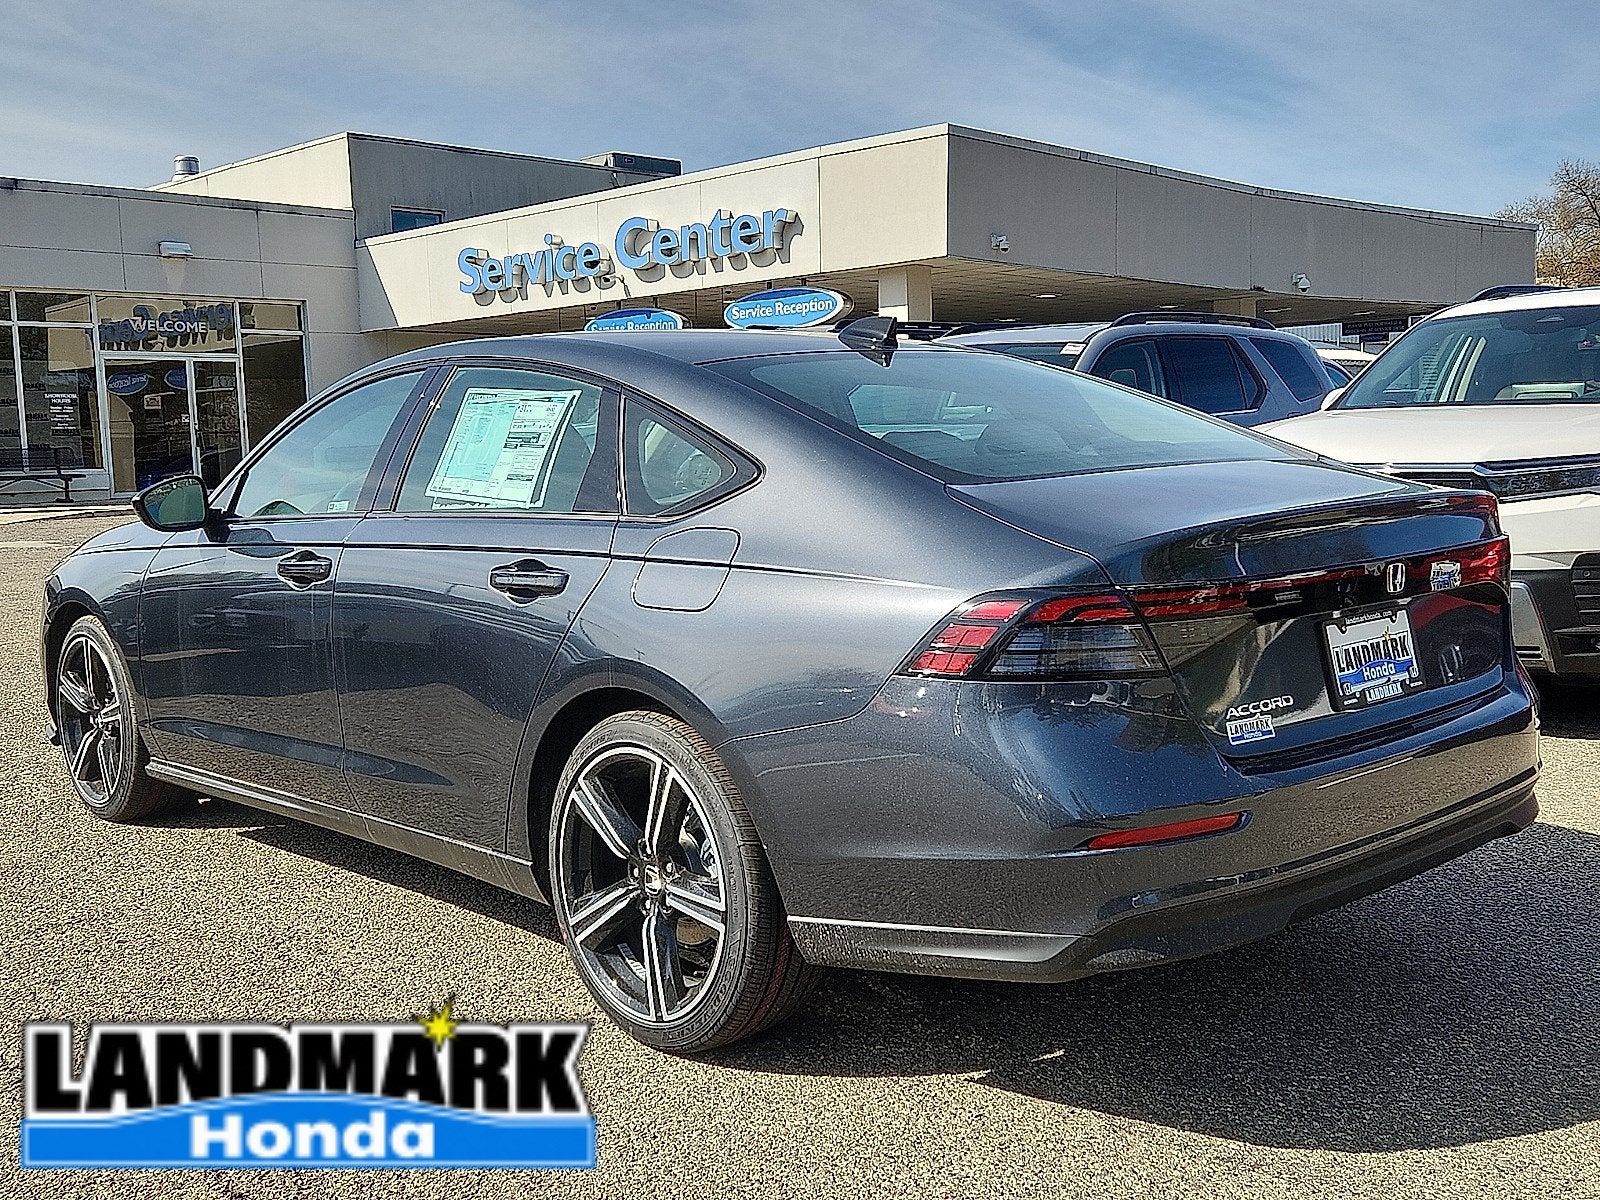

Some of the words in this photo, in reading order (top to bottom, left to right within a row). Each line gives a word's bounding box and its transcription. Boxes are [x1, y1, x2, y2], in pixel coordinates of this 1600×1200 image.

[457, 232, 602, 294] Service
[615, 208, 792, 270] Center
[731, 303, 773, 320] Service
[775, 297, 833, 317] Reception
[129, 318, 207, 333] WELCOME
[627, 318, 675, 331] Reception
[1333, 634, 1410, 674] LANDMARK
[1363, 661, 1396, 681] Honda
[1364, 681, 1404, 702] LANDMARK
[1226, 695, 1294, 720] ACCORD
[1228, 718, 1272, 736] LANDMARK
